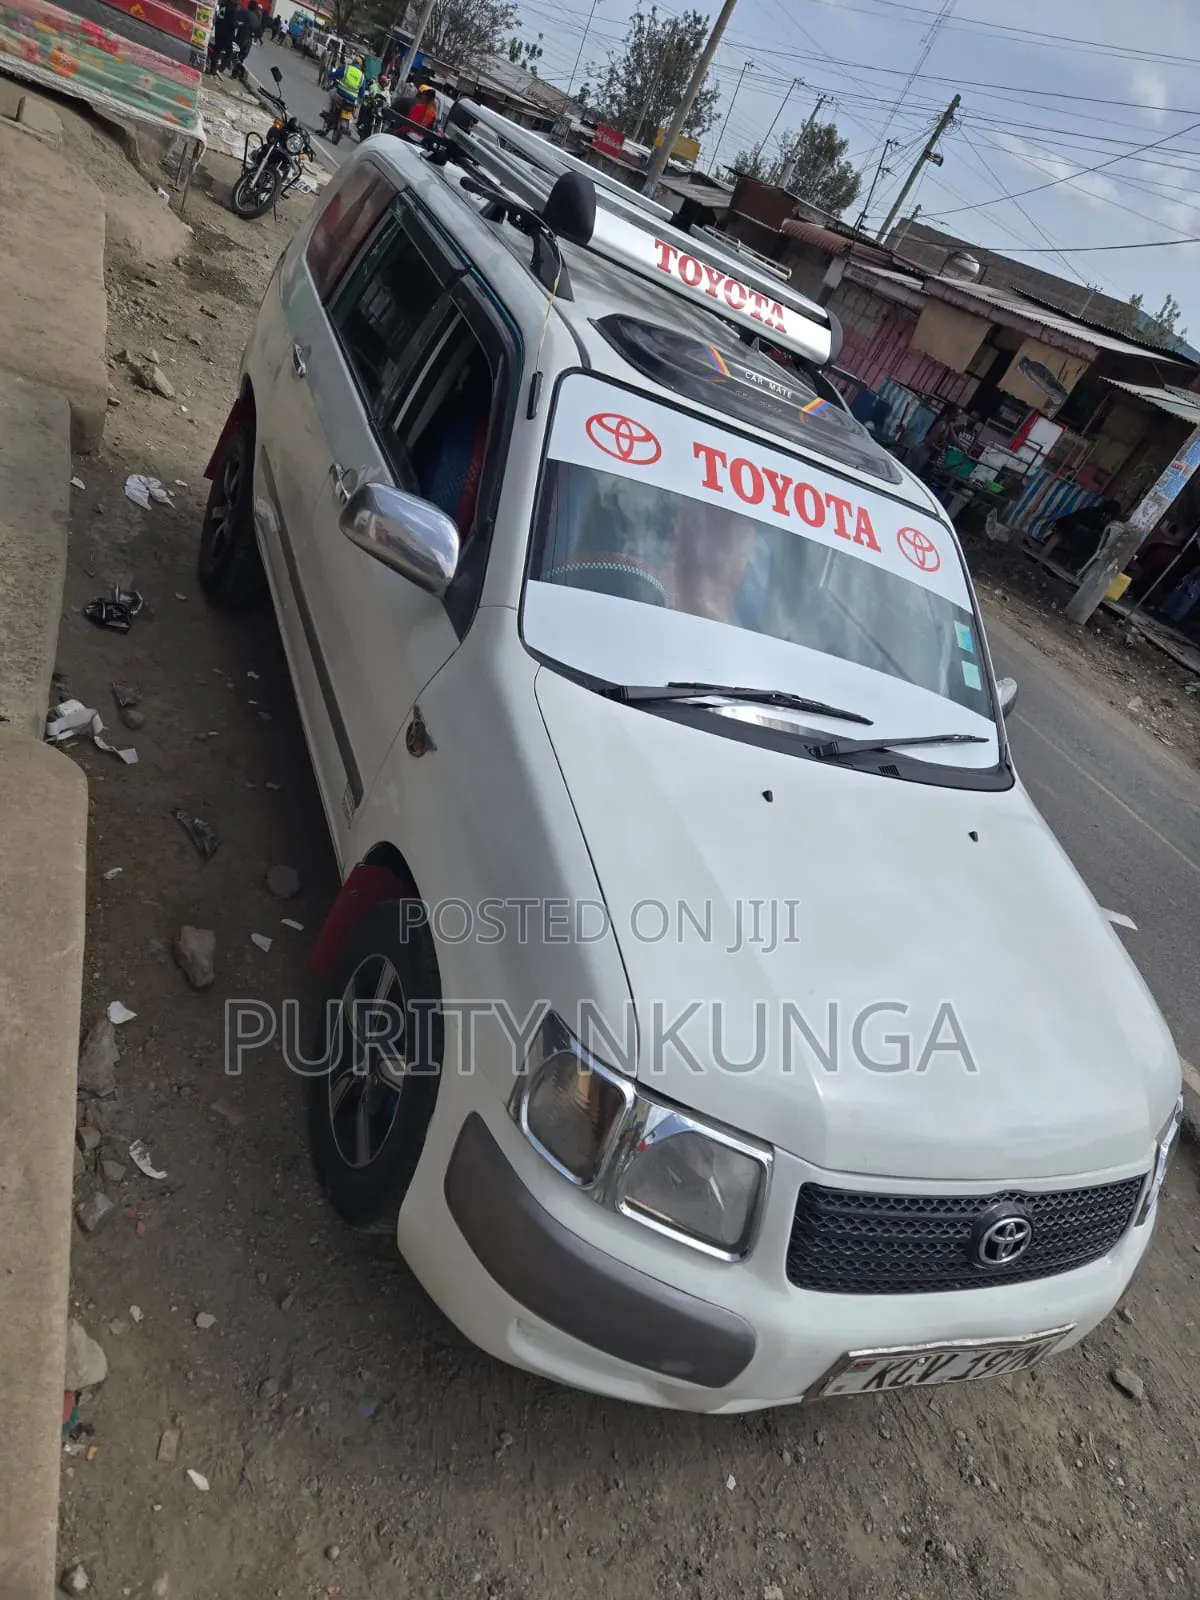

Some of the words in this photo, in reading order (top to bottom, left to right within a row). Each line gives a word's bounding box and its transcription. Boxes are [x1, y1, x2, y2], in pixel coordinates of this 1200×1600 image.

[654, 238, 787, 334] TOYOTA
[744, 370, 763, 385] CAR
[768, 382, 793, 399] MATE
[693, 441, 882, 553] TOYOTA
[861, 1353, 960, 1391] KCV
